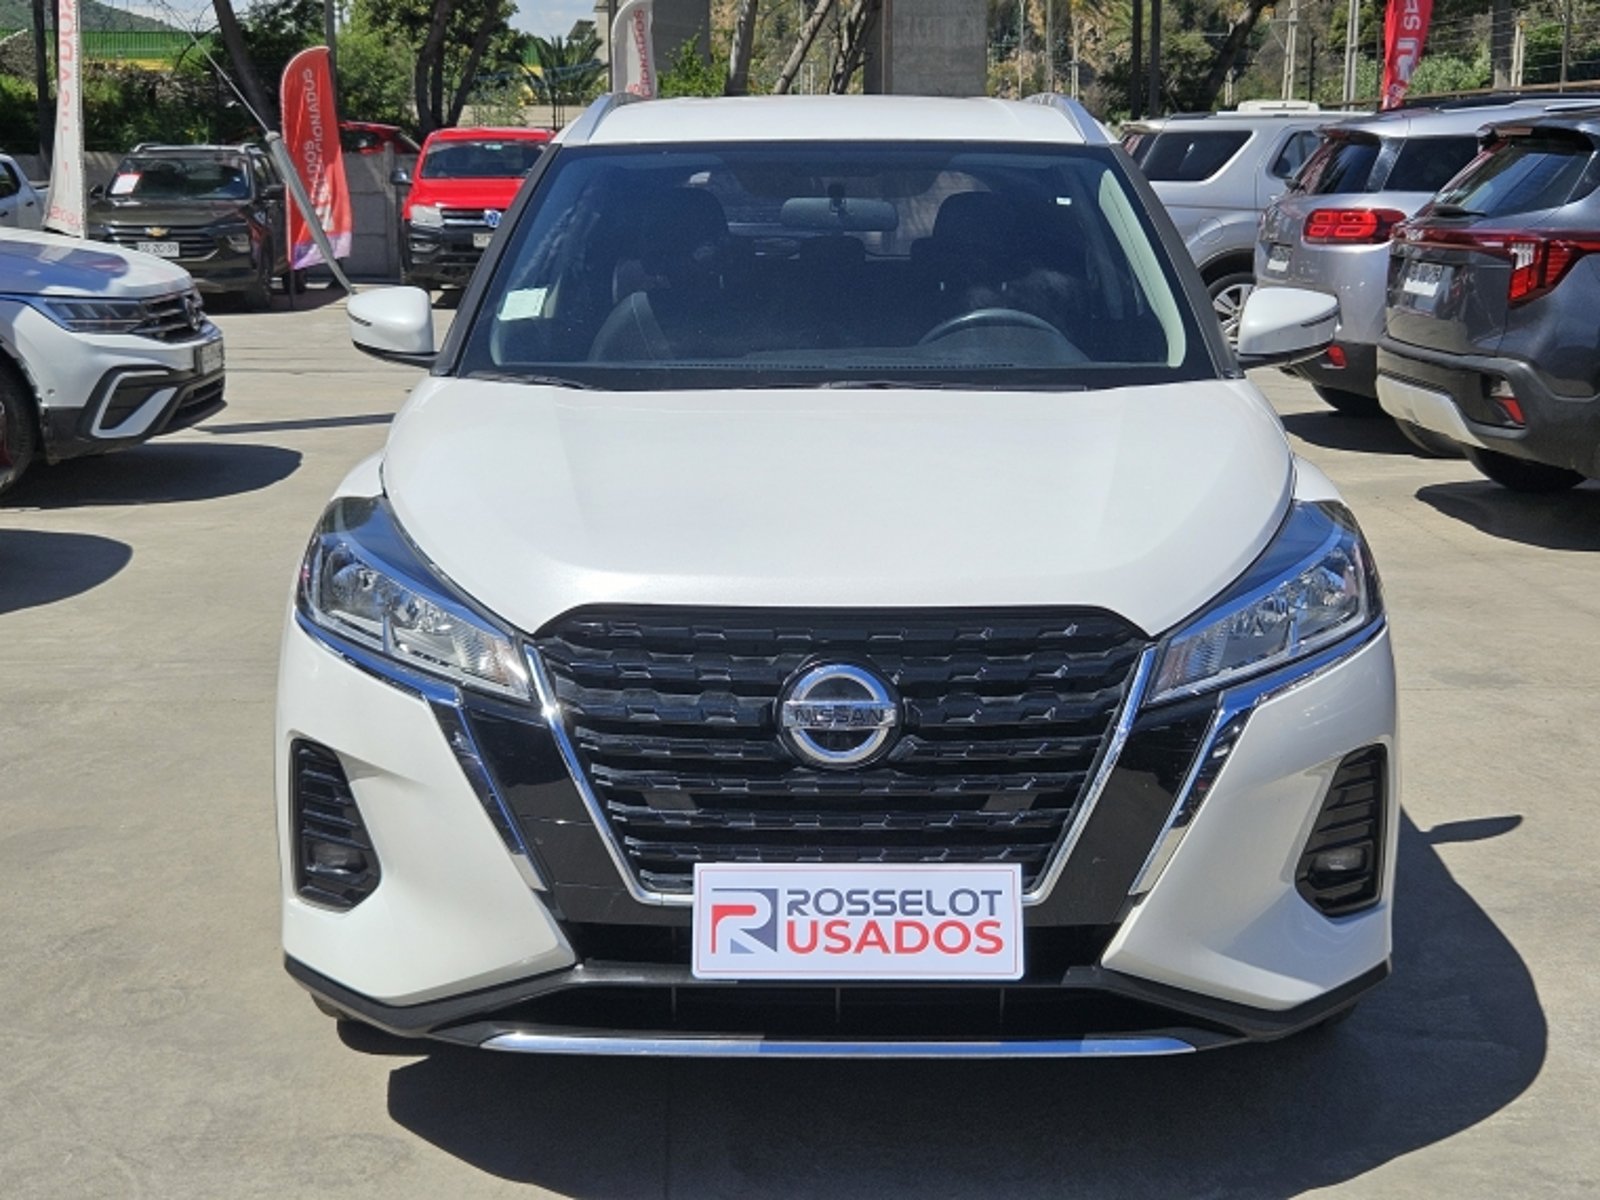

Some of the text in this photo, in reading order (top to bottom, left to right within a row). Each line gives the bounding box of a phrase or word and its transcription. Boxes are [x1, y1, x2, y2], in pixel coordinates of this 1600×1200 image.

[794, 707, 885, 724] NISSAN
[786, 888, 1003, 916] ROSSELOT
[786, 919, 1004, 954] USADOS
